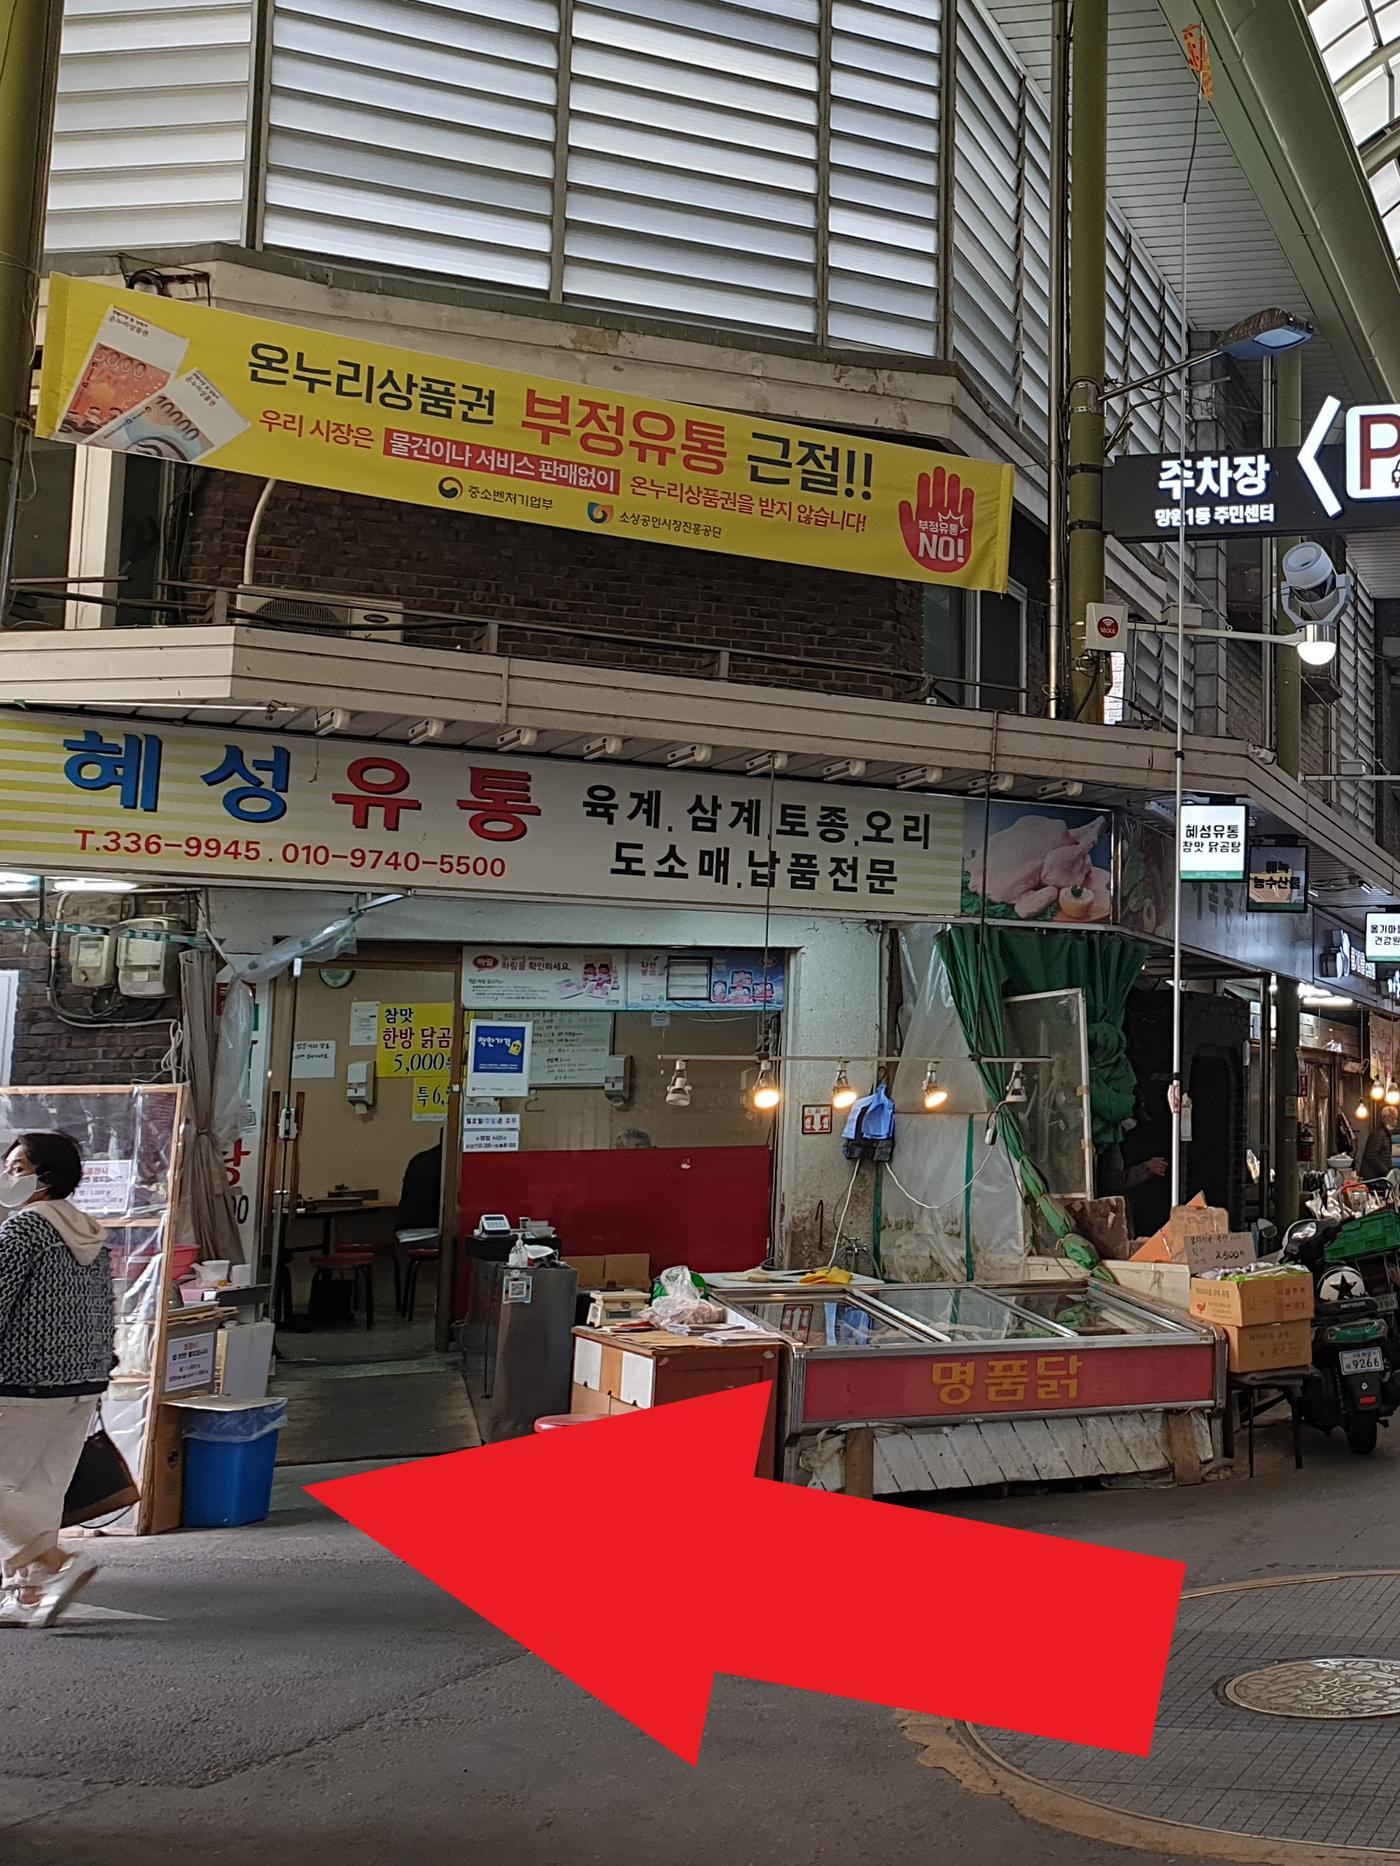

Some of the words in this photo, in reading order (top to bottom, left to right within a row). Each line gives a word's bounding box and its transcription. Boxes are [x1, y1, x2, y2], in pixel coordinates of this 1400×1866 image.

[155, 393, 200, 441] 10000
[248, 343, 495, 425] 온누리상품권
[521, 388, 728, 476] 부정유통
[747, 432, 874, 501] 근절!!
[259, 410, 304, 438] 우리
[309, 418, 375, 450] 시장은
[389, 432, 473, 467] 물건이나
[476, 449, 536, 475] 서비스
[538, 459, 615, 493] 판매없이
[630, 475, 755, 514] 온누리상품권을
[759, 496, 793, 522] 받지
[797, 504, 867, 533] 않습니다!
[1158, 455, 1270, 501] 주차장
[467, 485, 554, 511] 중소벤처기업부
[619, 511, 722, 539] 소상공인시장진흥공단
[1154, 507, 1211, 527] 망원1동
[1214, 503, 1275, 526] 주민센터
[918, 533, 965, 564] NO!
[1185, 824, 1240, 839] 혜성유통
[1208, 841, 1241, 853] 닭곰탕
[1253, 876, 1301, 889] 농수산물
[1374, 936, 1400, 946] 건강원
[384, 1007, 415, 1025] 참맛
[382, 1026, 415, 1050] 한방
[420, 1026, 452, 1050] 닭곰
[416, 1086, 429, 1107] 특
[1352, 1357, 1380, 1370] 9266
[931, 1355, 1083, 1404] 명품닭
